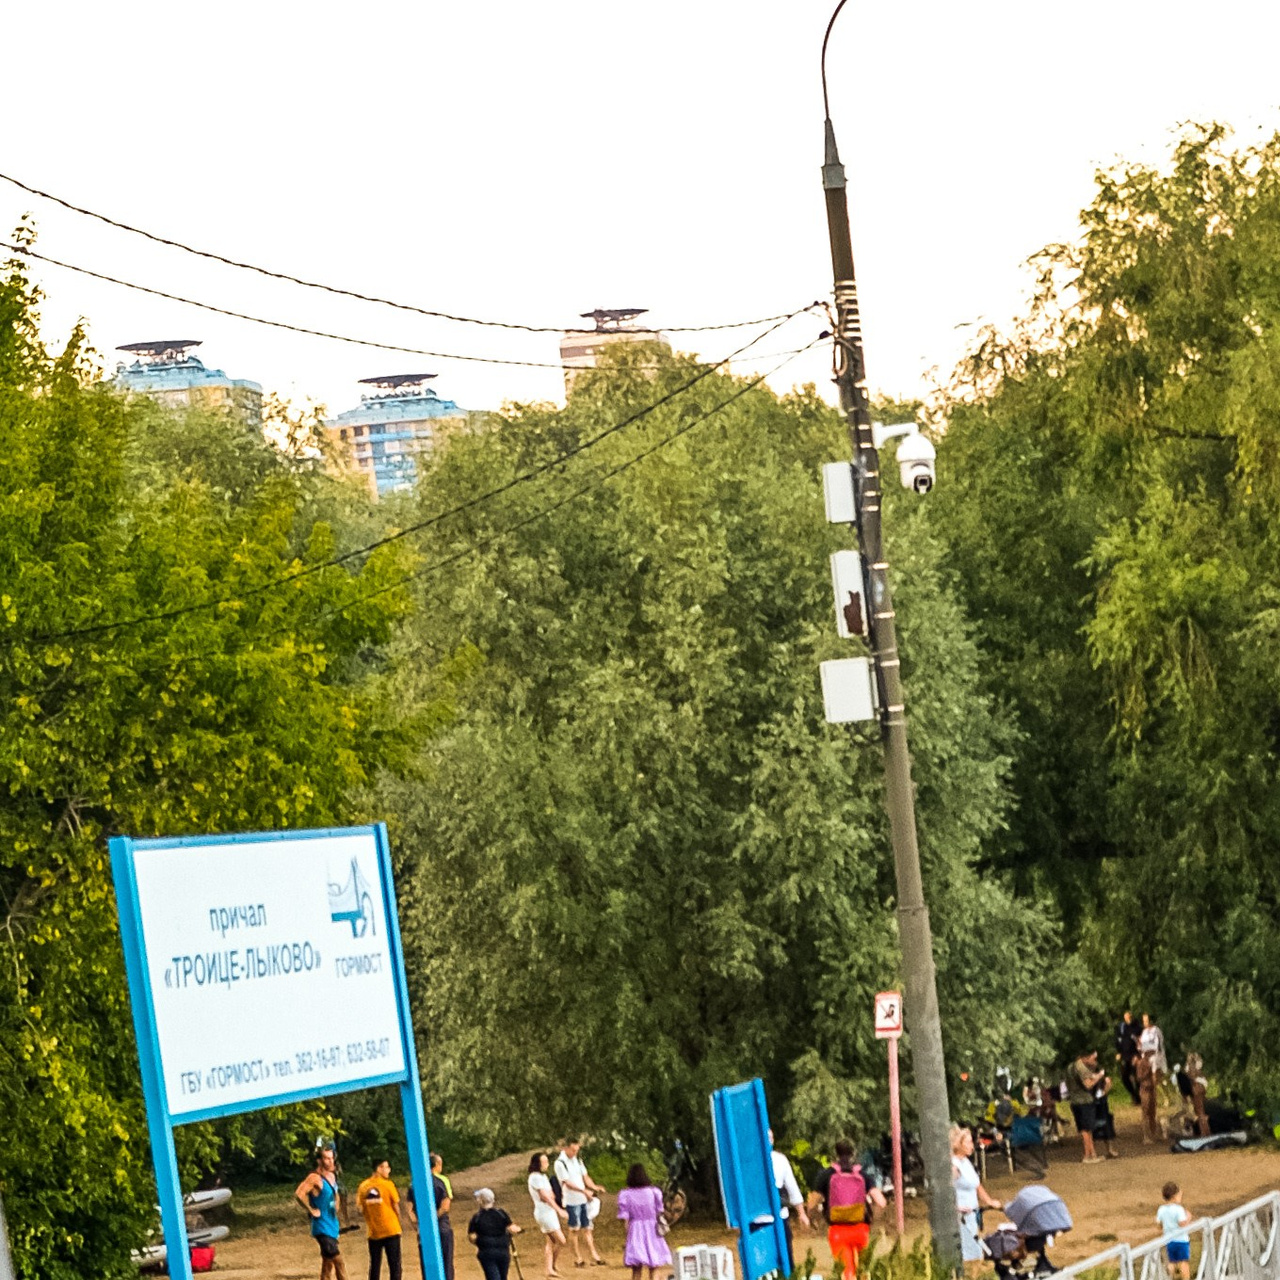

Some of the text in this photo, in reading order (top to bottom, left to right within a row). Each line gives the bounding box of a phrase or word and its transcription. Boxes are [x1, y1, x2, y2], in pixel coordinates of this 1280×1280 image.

[209, 903, 267, 938] причал
[335, 952, 383, 979] ГОРМОСТ
[181, 1071, 202, 1095] ГБУ
[206, 1060, 271, 1090] «ГОРМОСТ»
